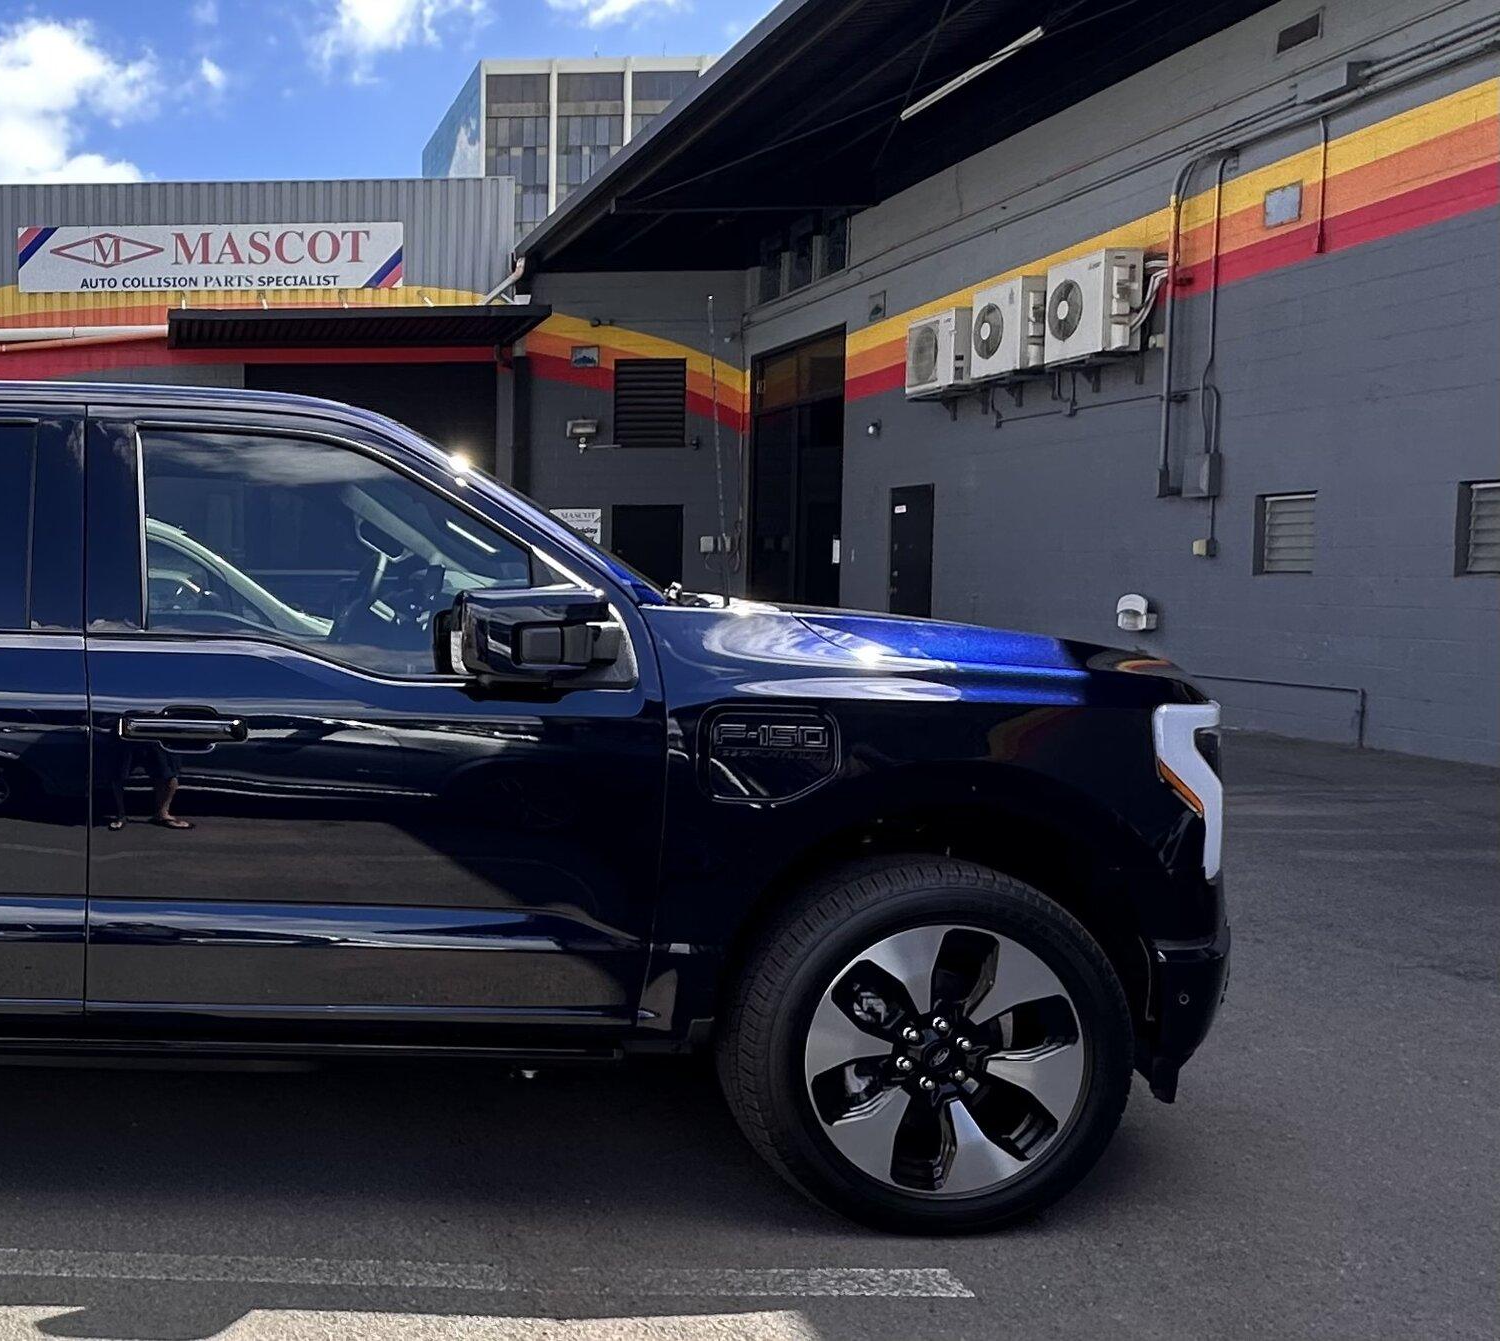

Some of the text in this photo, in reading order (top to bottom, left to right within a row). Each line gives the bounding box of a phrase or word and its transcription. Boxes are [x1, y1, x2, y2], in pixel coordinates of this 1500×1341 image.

[91, 238, 123, 264] M
[170, 230, 370, 265] MASCOT
[80, 274, 339, 289] AUTO COLLISION PARTS SPECIALIST
[713, 723, 829, 748] F-150
